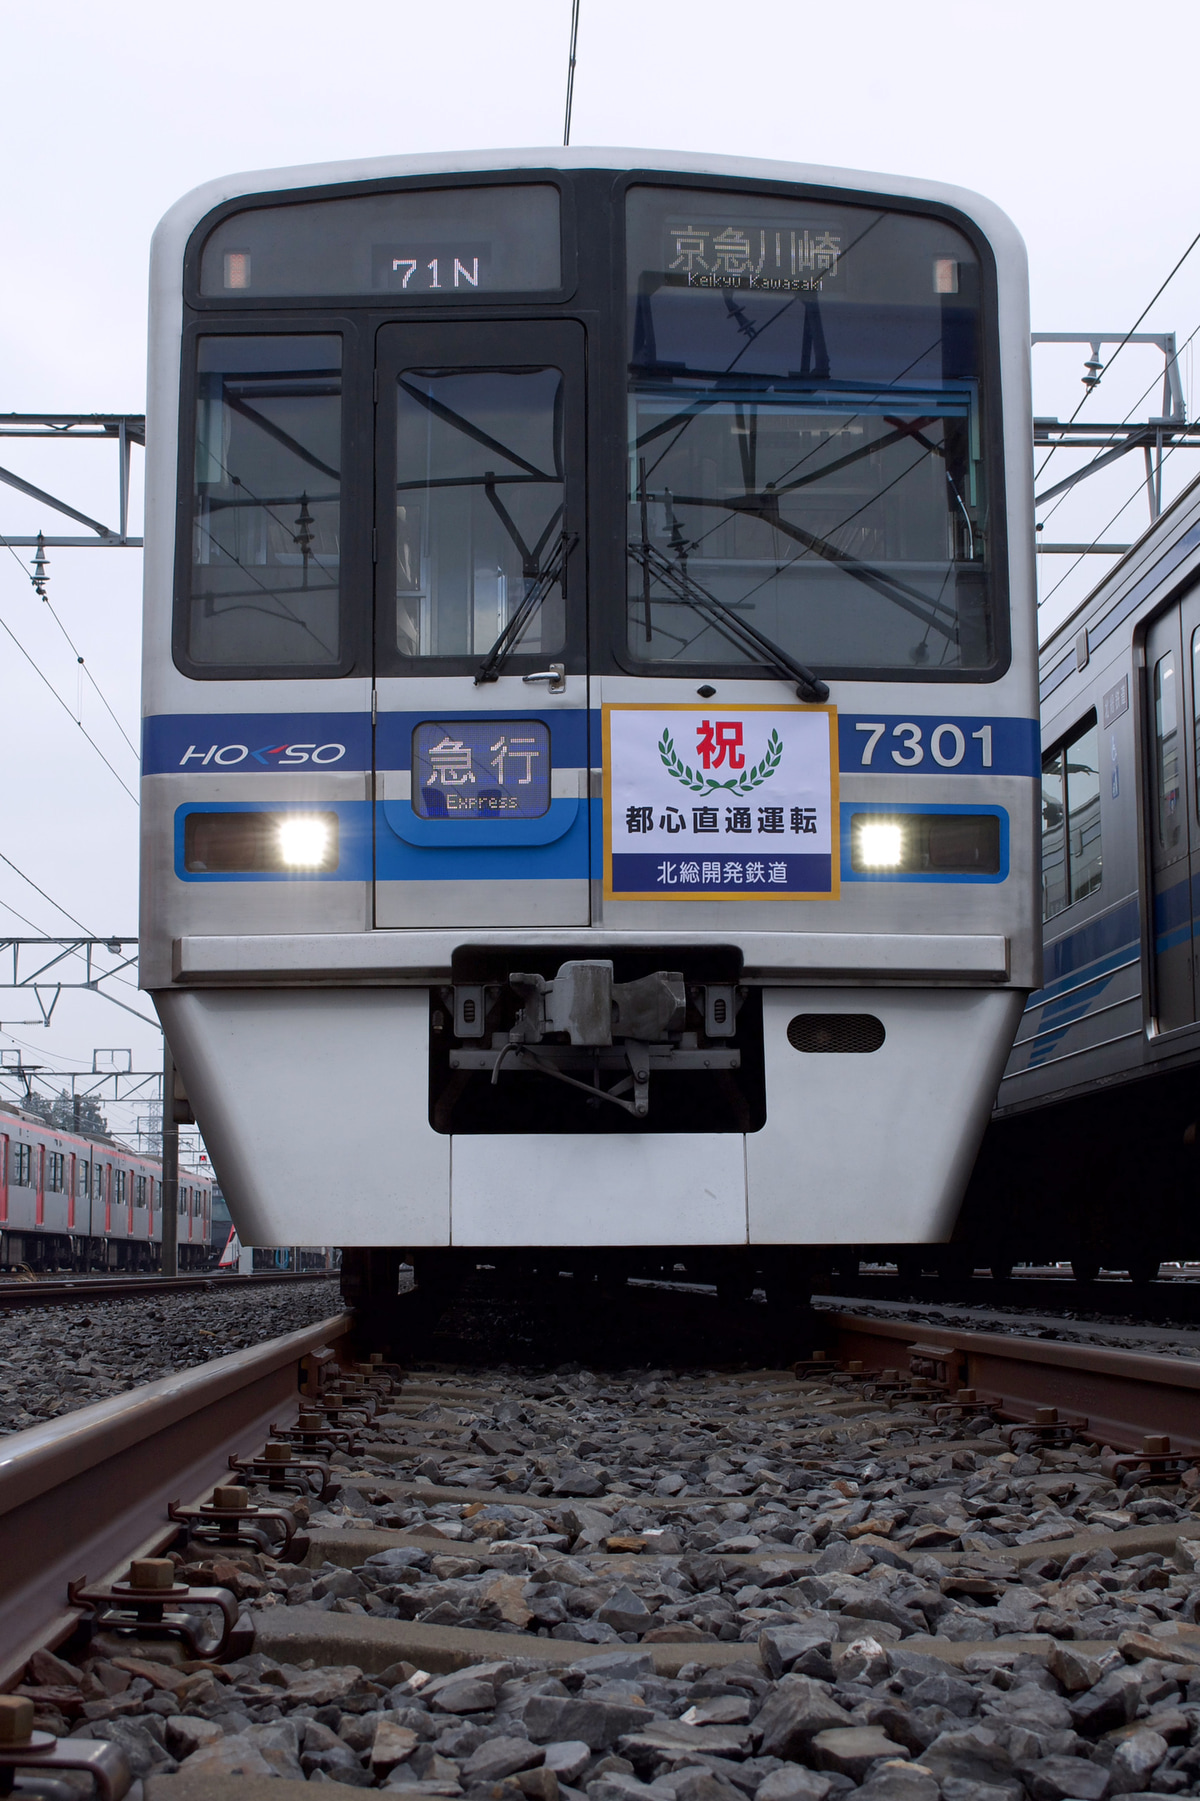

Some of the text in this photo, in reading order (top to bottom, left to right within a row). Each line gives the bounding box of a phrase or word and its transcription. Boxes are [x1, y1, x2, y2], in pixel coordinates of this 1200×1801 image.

[668, 225, 842, 277] 京急川崎
[392, 257, 479, 289] 71N
[749, 274, 823, 291] Kawasaki
[696, 720, 745, 770] 祝
[855, 723, 993, 767] 7301
[427, 737, 539, 786] 急行
[446, 794, 519, 811] Express
[626, 806, 818, 834] 都心直通運転
[656, 861, 788, 885] 北総開発鉄道
